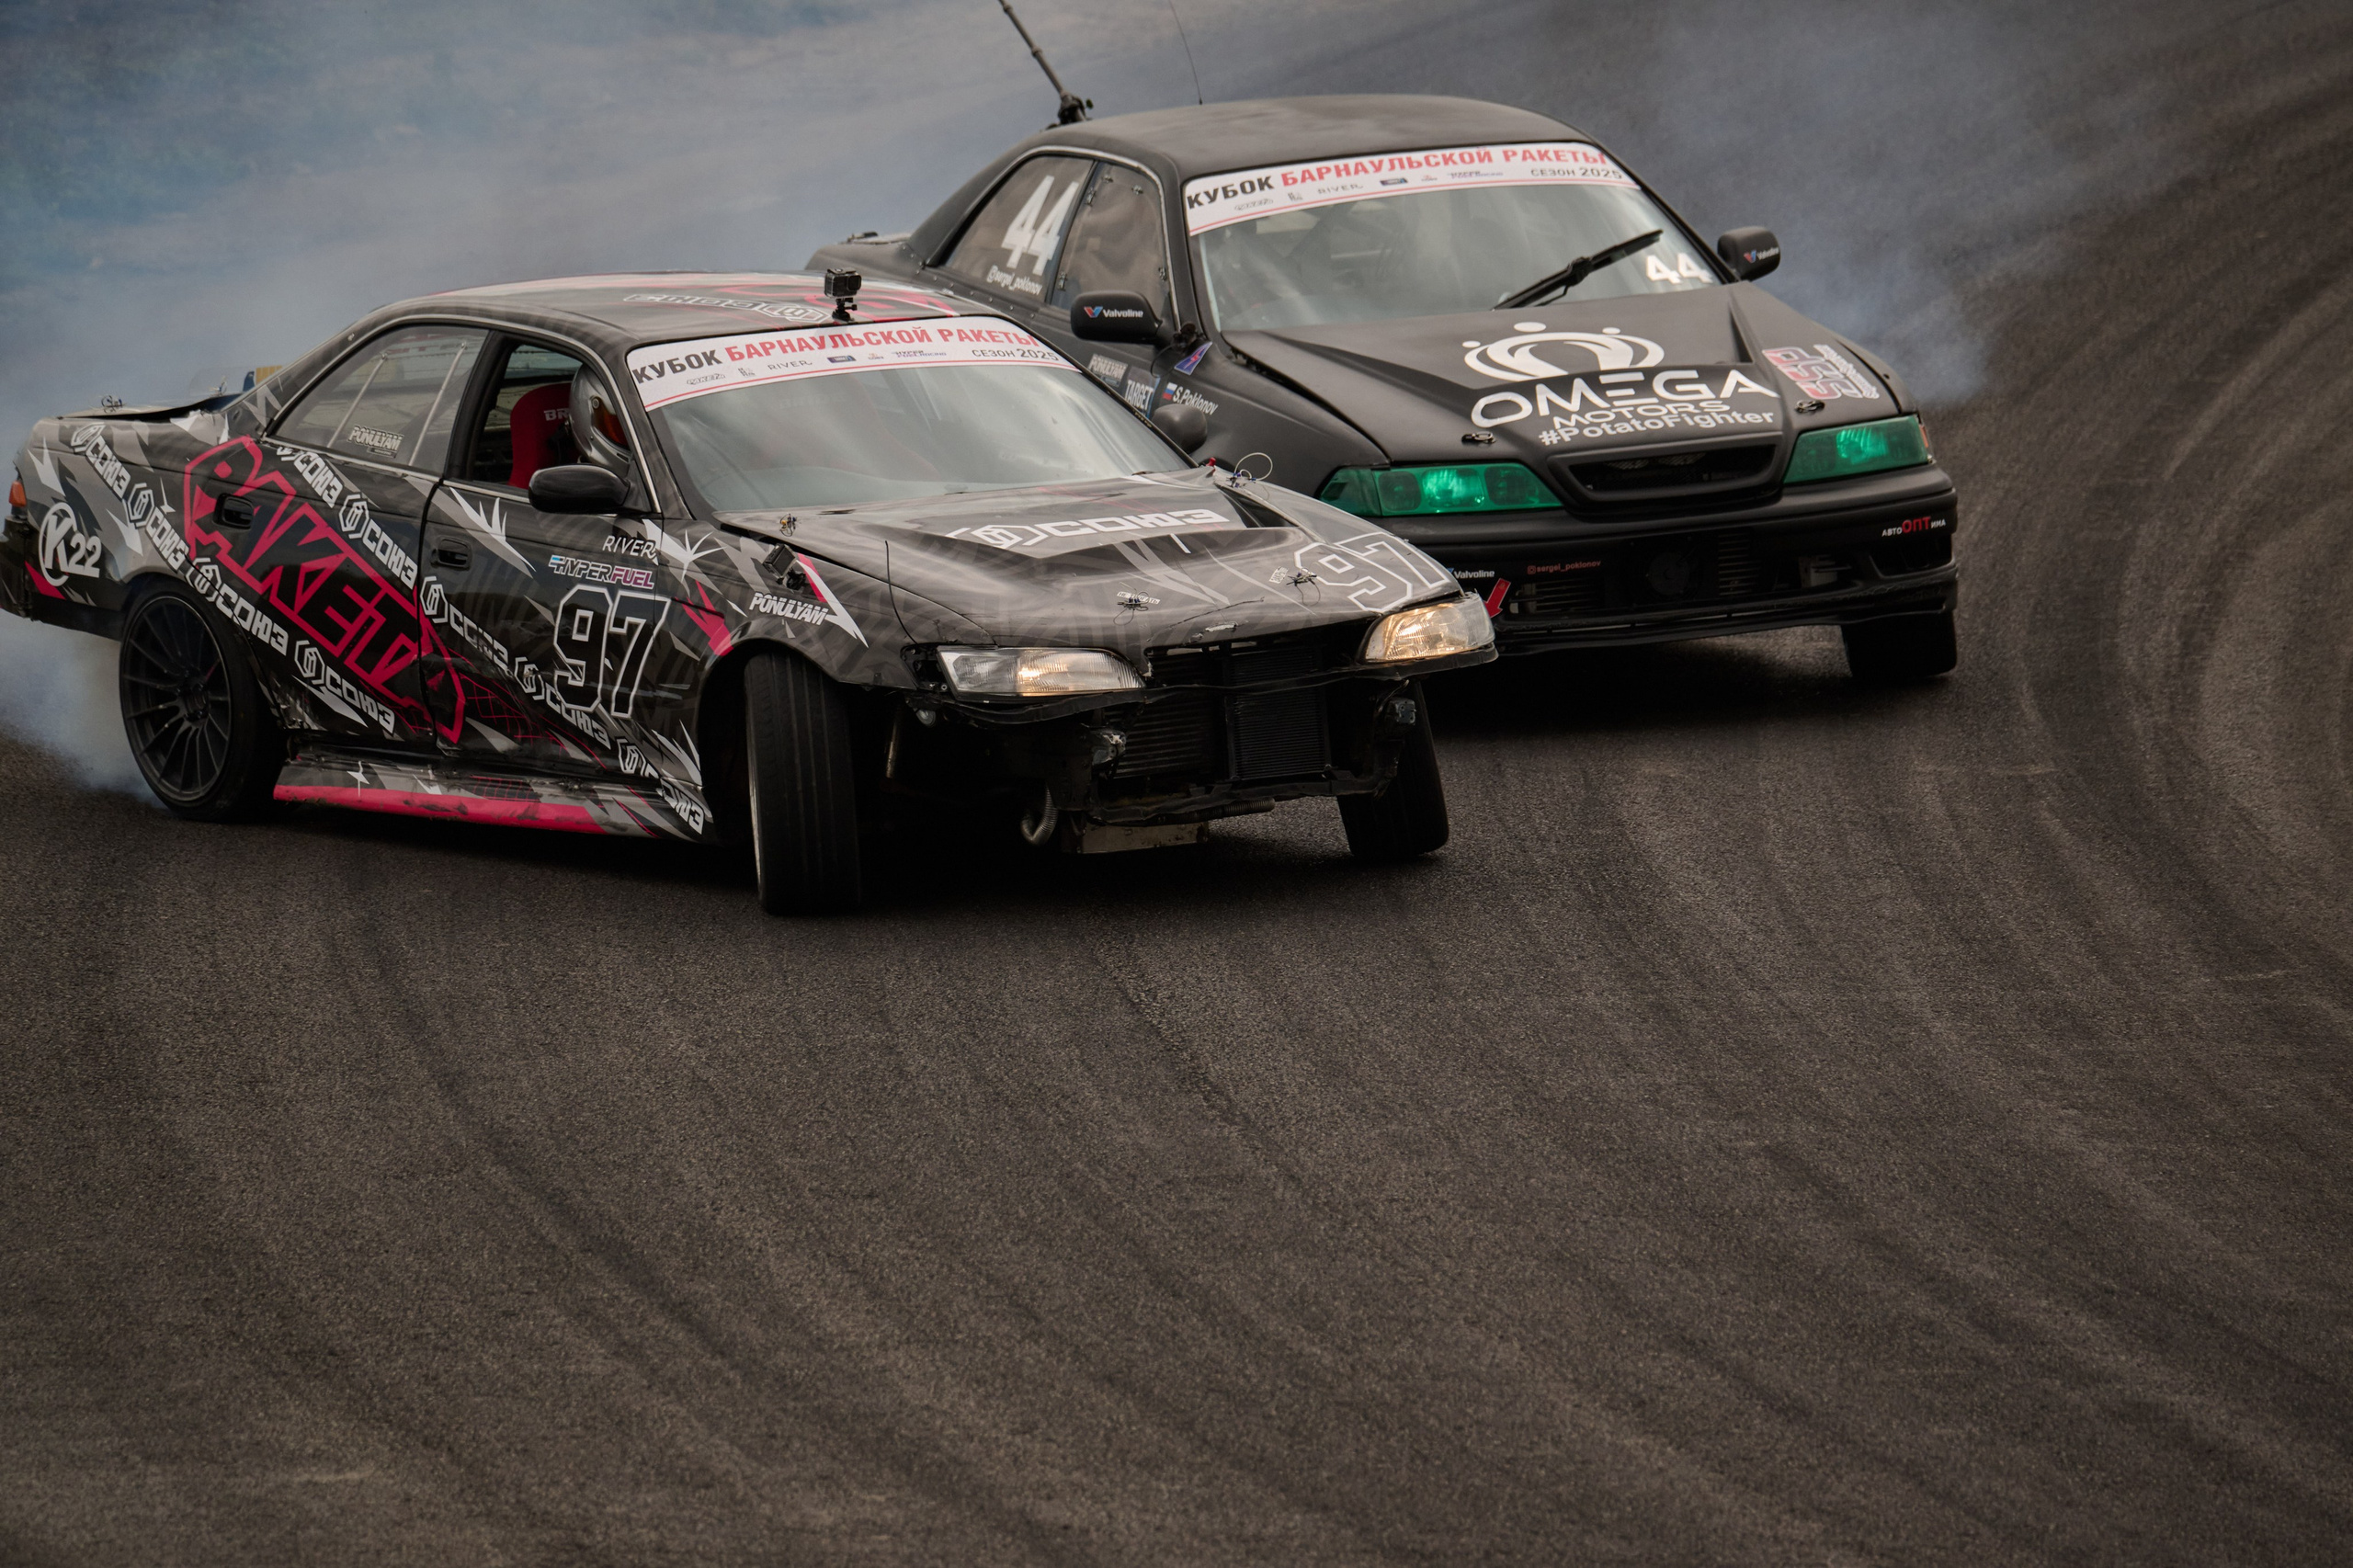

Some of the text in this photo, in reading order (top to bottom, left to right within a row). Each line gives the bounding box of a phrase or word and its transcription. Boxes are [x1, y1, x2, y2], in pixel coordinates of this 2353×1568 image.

[1187, 176, 1275, 210] КУБОК
[1281, 147, 1493, 187] БАРНАУЛЬСКОЙ
[1503, 149, 1608, 165] РАКЕТЫ
[1531, 166, 1623, 179] СЕЗОН 2025
[1001, 175, 1080, 276] 44
[1646, 253, 1713, 284] 44
[1103, 309, 1144, 318] Valvoline
[632, 325, 1040, 385] КУБОК БАРНАУЛЬСКОЙ РАКЕТЫ
[767, 359, 813, 371] RIVER
[972, 347, 1060, 361] СЕЗОН 2025
[1472, 369, 1781, 428] OMEGA
[1539, 412, 1775, 447] #PotatoFighter
[1553, 400, 1732, 430] MOTORS
[602, 535, 656, 560] RIVER
[1294, 531, 1453, 613] 97
[1453, 570, 1495, 580] Valvoline
[1537, 561, 1602, 574] sergei_poklonov
[749, 592, 829, 625] PONULYAM
[553, 584, 671, 718] 97
